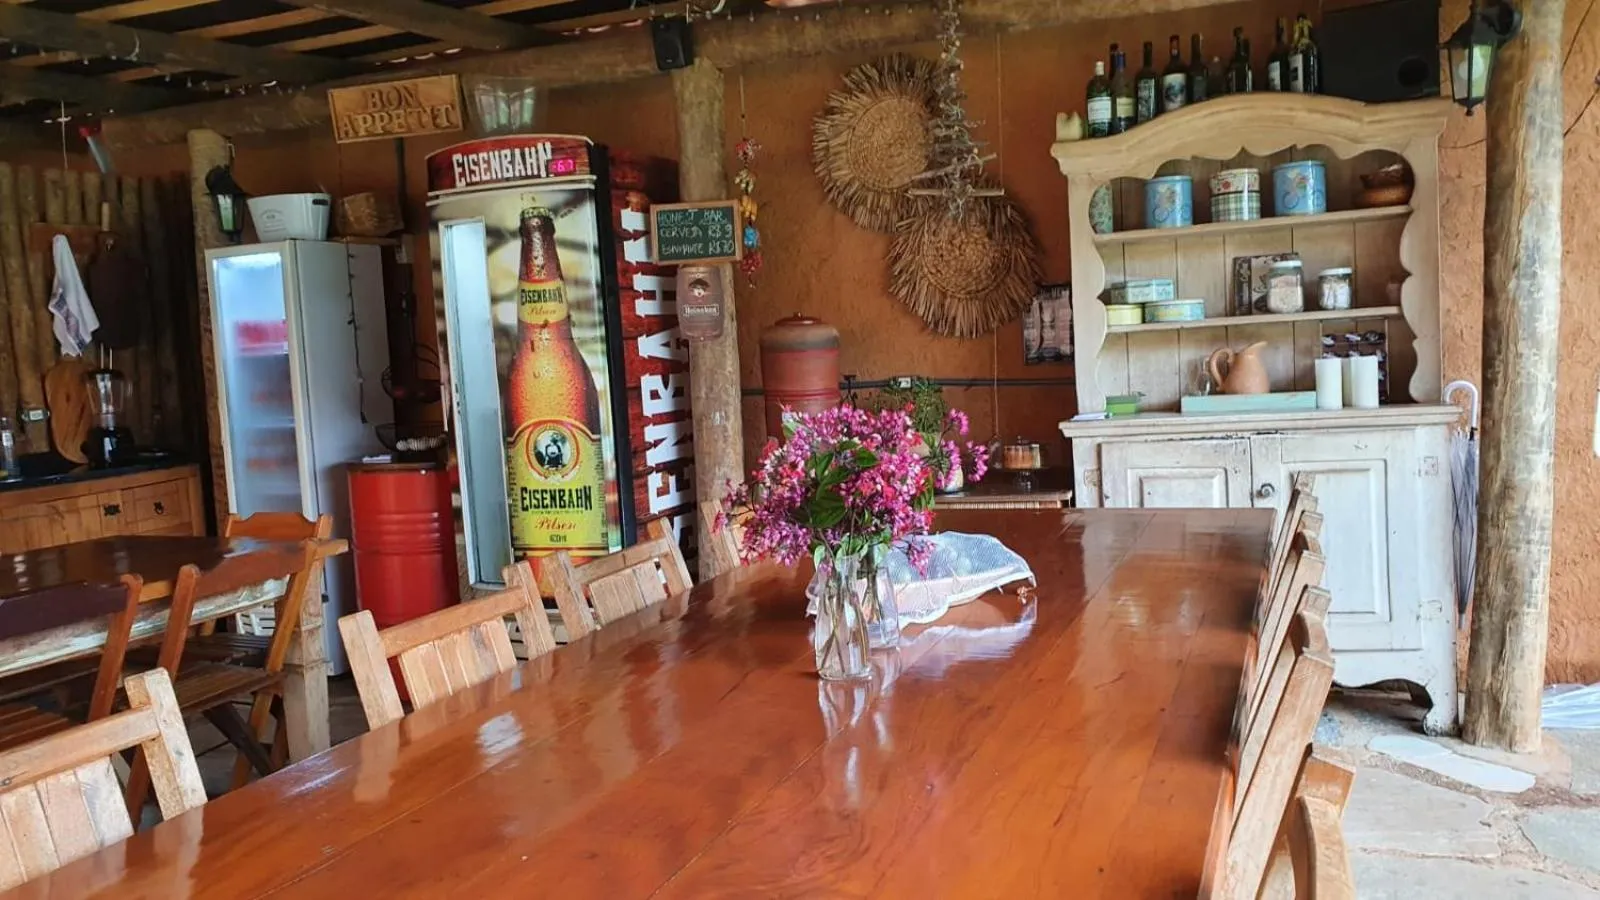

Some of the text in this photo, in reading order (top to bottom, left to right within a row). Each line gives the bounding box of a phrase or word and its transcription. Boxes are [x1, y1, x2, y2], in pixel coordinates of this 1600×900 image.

[366, 83, 418, 112] BON
[339, 103, 455, 138] APPETIT
[452, 142, 552, 188] EISENBAHN
[703, 209, 724, 222] BAR
[520, 286, 564, 306] EISENBAHN
[520, 485, 593, 512] EISENBAHN
[534, 516, 577, 530] Pilsen
